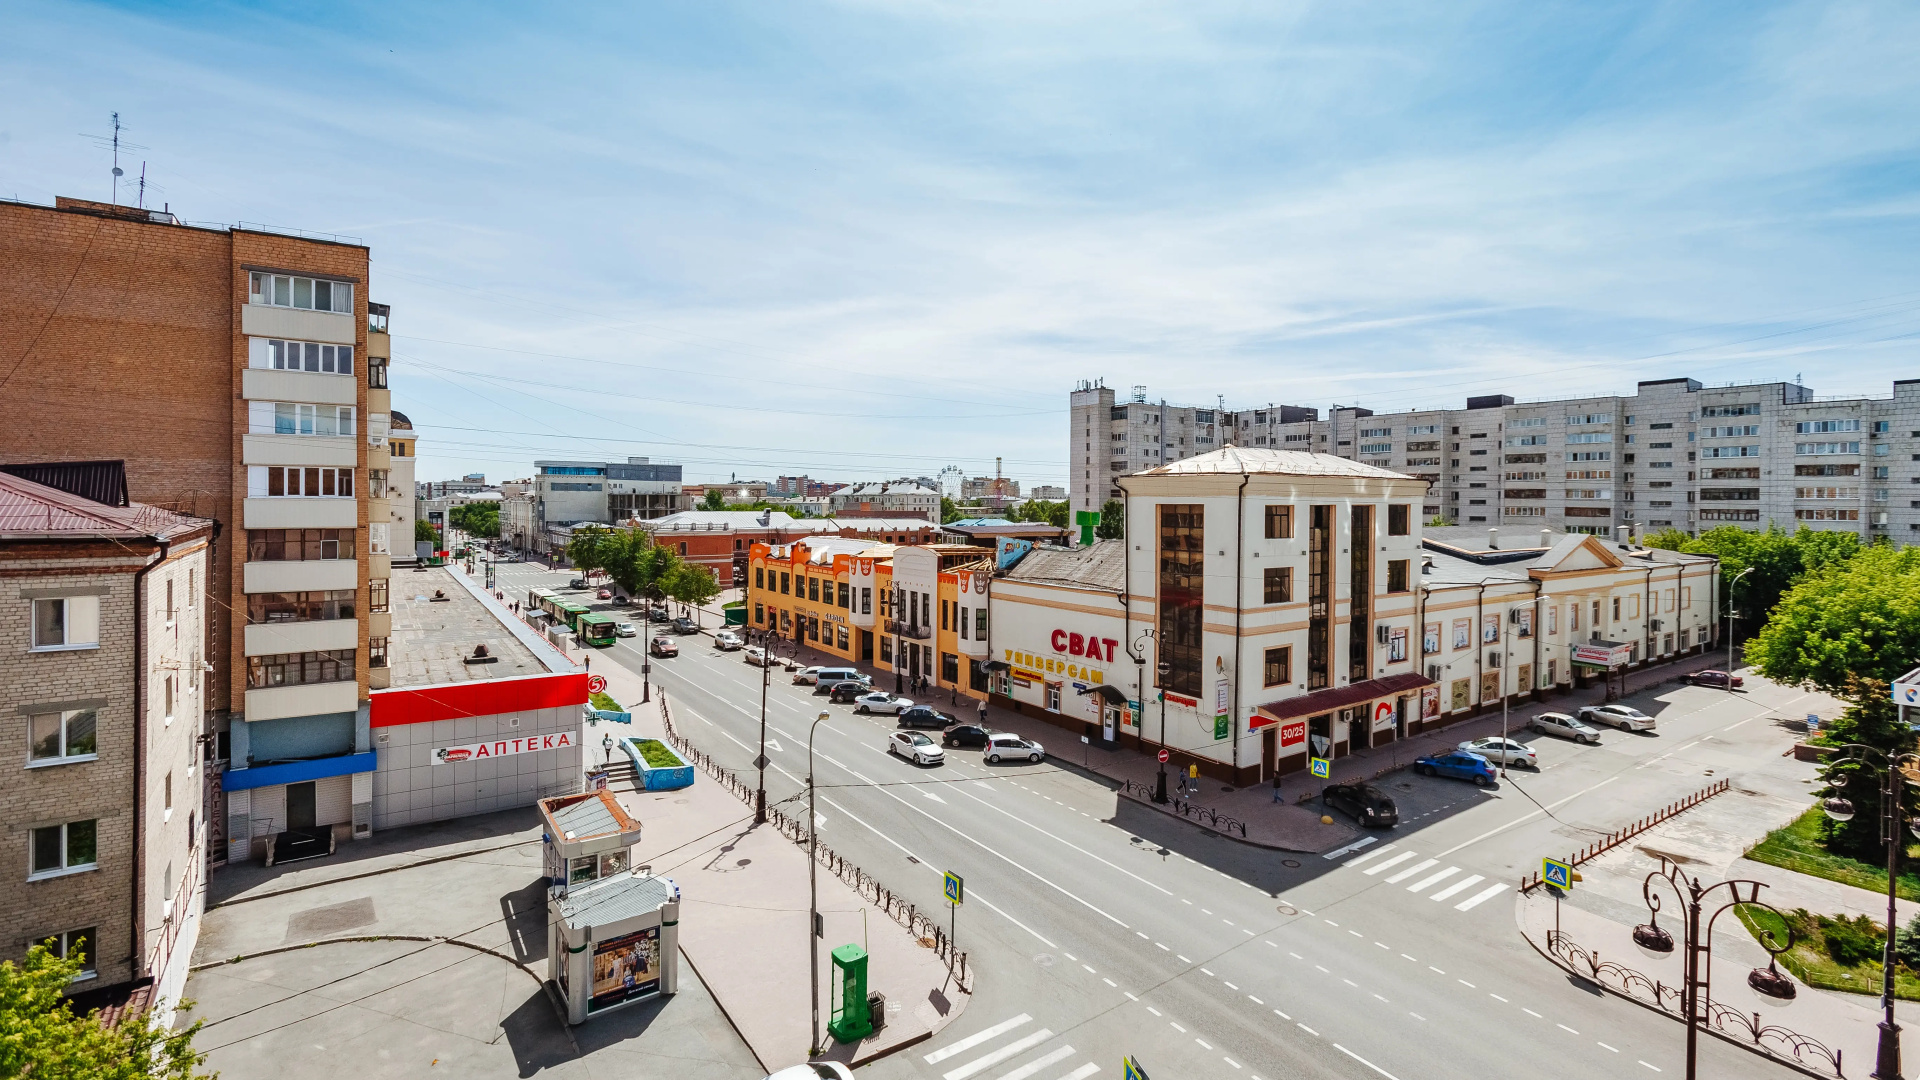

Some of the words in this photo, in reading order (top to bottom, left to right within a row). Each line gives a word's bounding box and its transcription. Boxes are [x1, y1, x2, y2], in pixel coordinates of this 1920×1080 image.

[1051, 629, 1118, 663] СВАТ
[1005, 649, 1103, 684] УНИВЕРСАМ
[476, 733, 571, 758] АПТЕКА
[1282, 725, 1304, 740] 30/25
[212, 781, 221, 836] АПТЕКА
